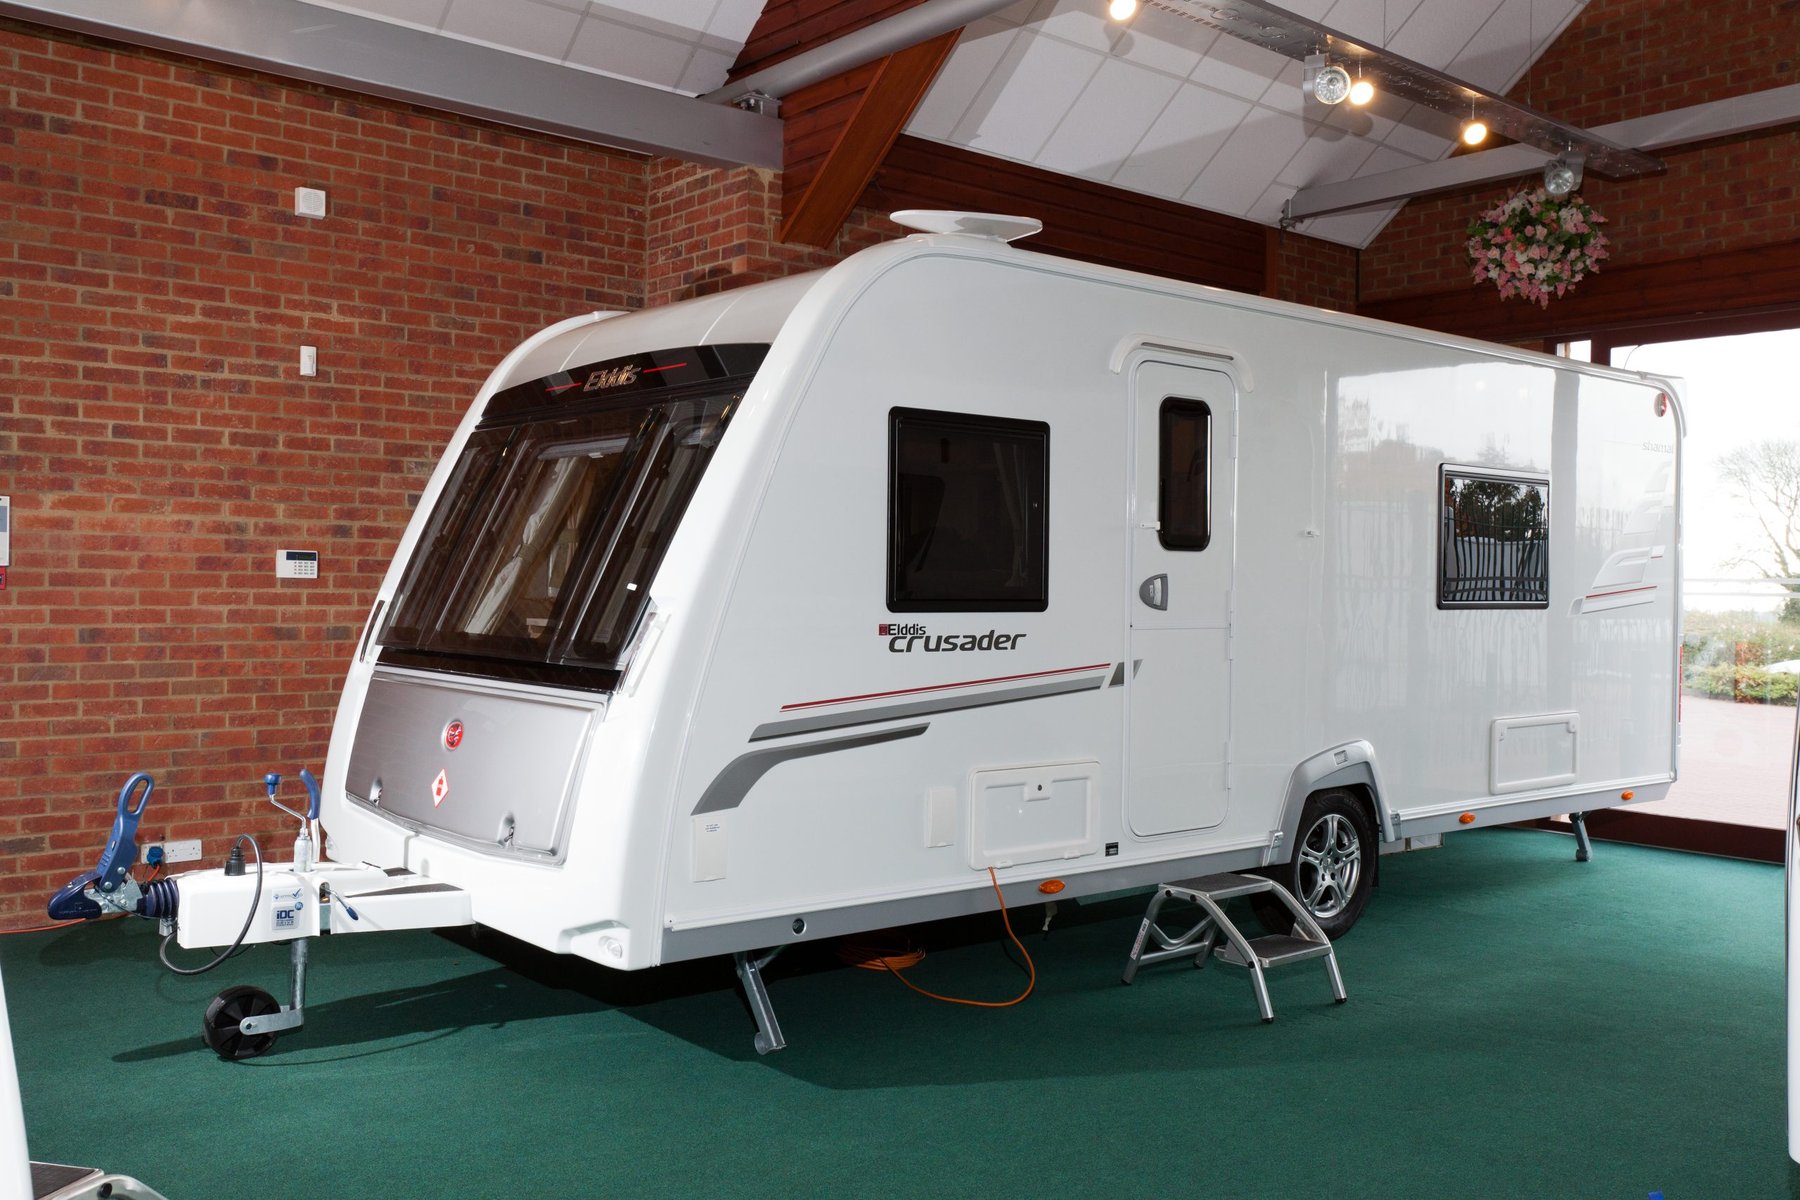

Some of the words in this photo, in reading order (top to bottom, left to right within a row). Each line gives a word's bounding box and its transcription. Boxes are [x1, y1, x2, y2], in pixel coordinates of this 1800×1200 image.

[583, 364, 641, 391] Elddis
[888, 623, 927, 636] Elddis
[888, 629, 1027, 653] crusader
